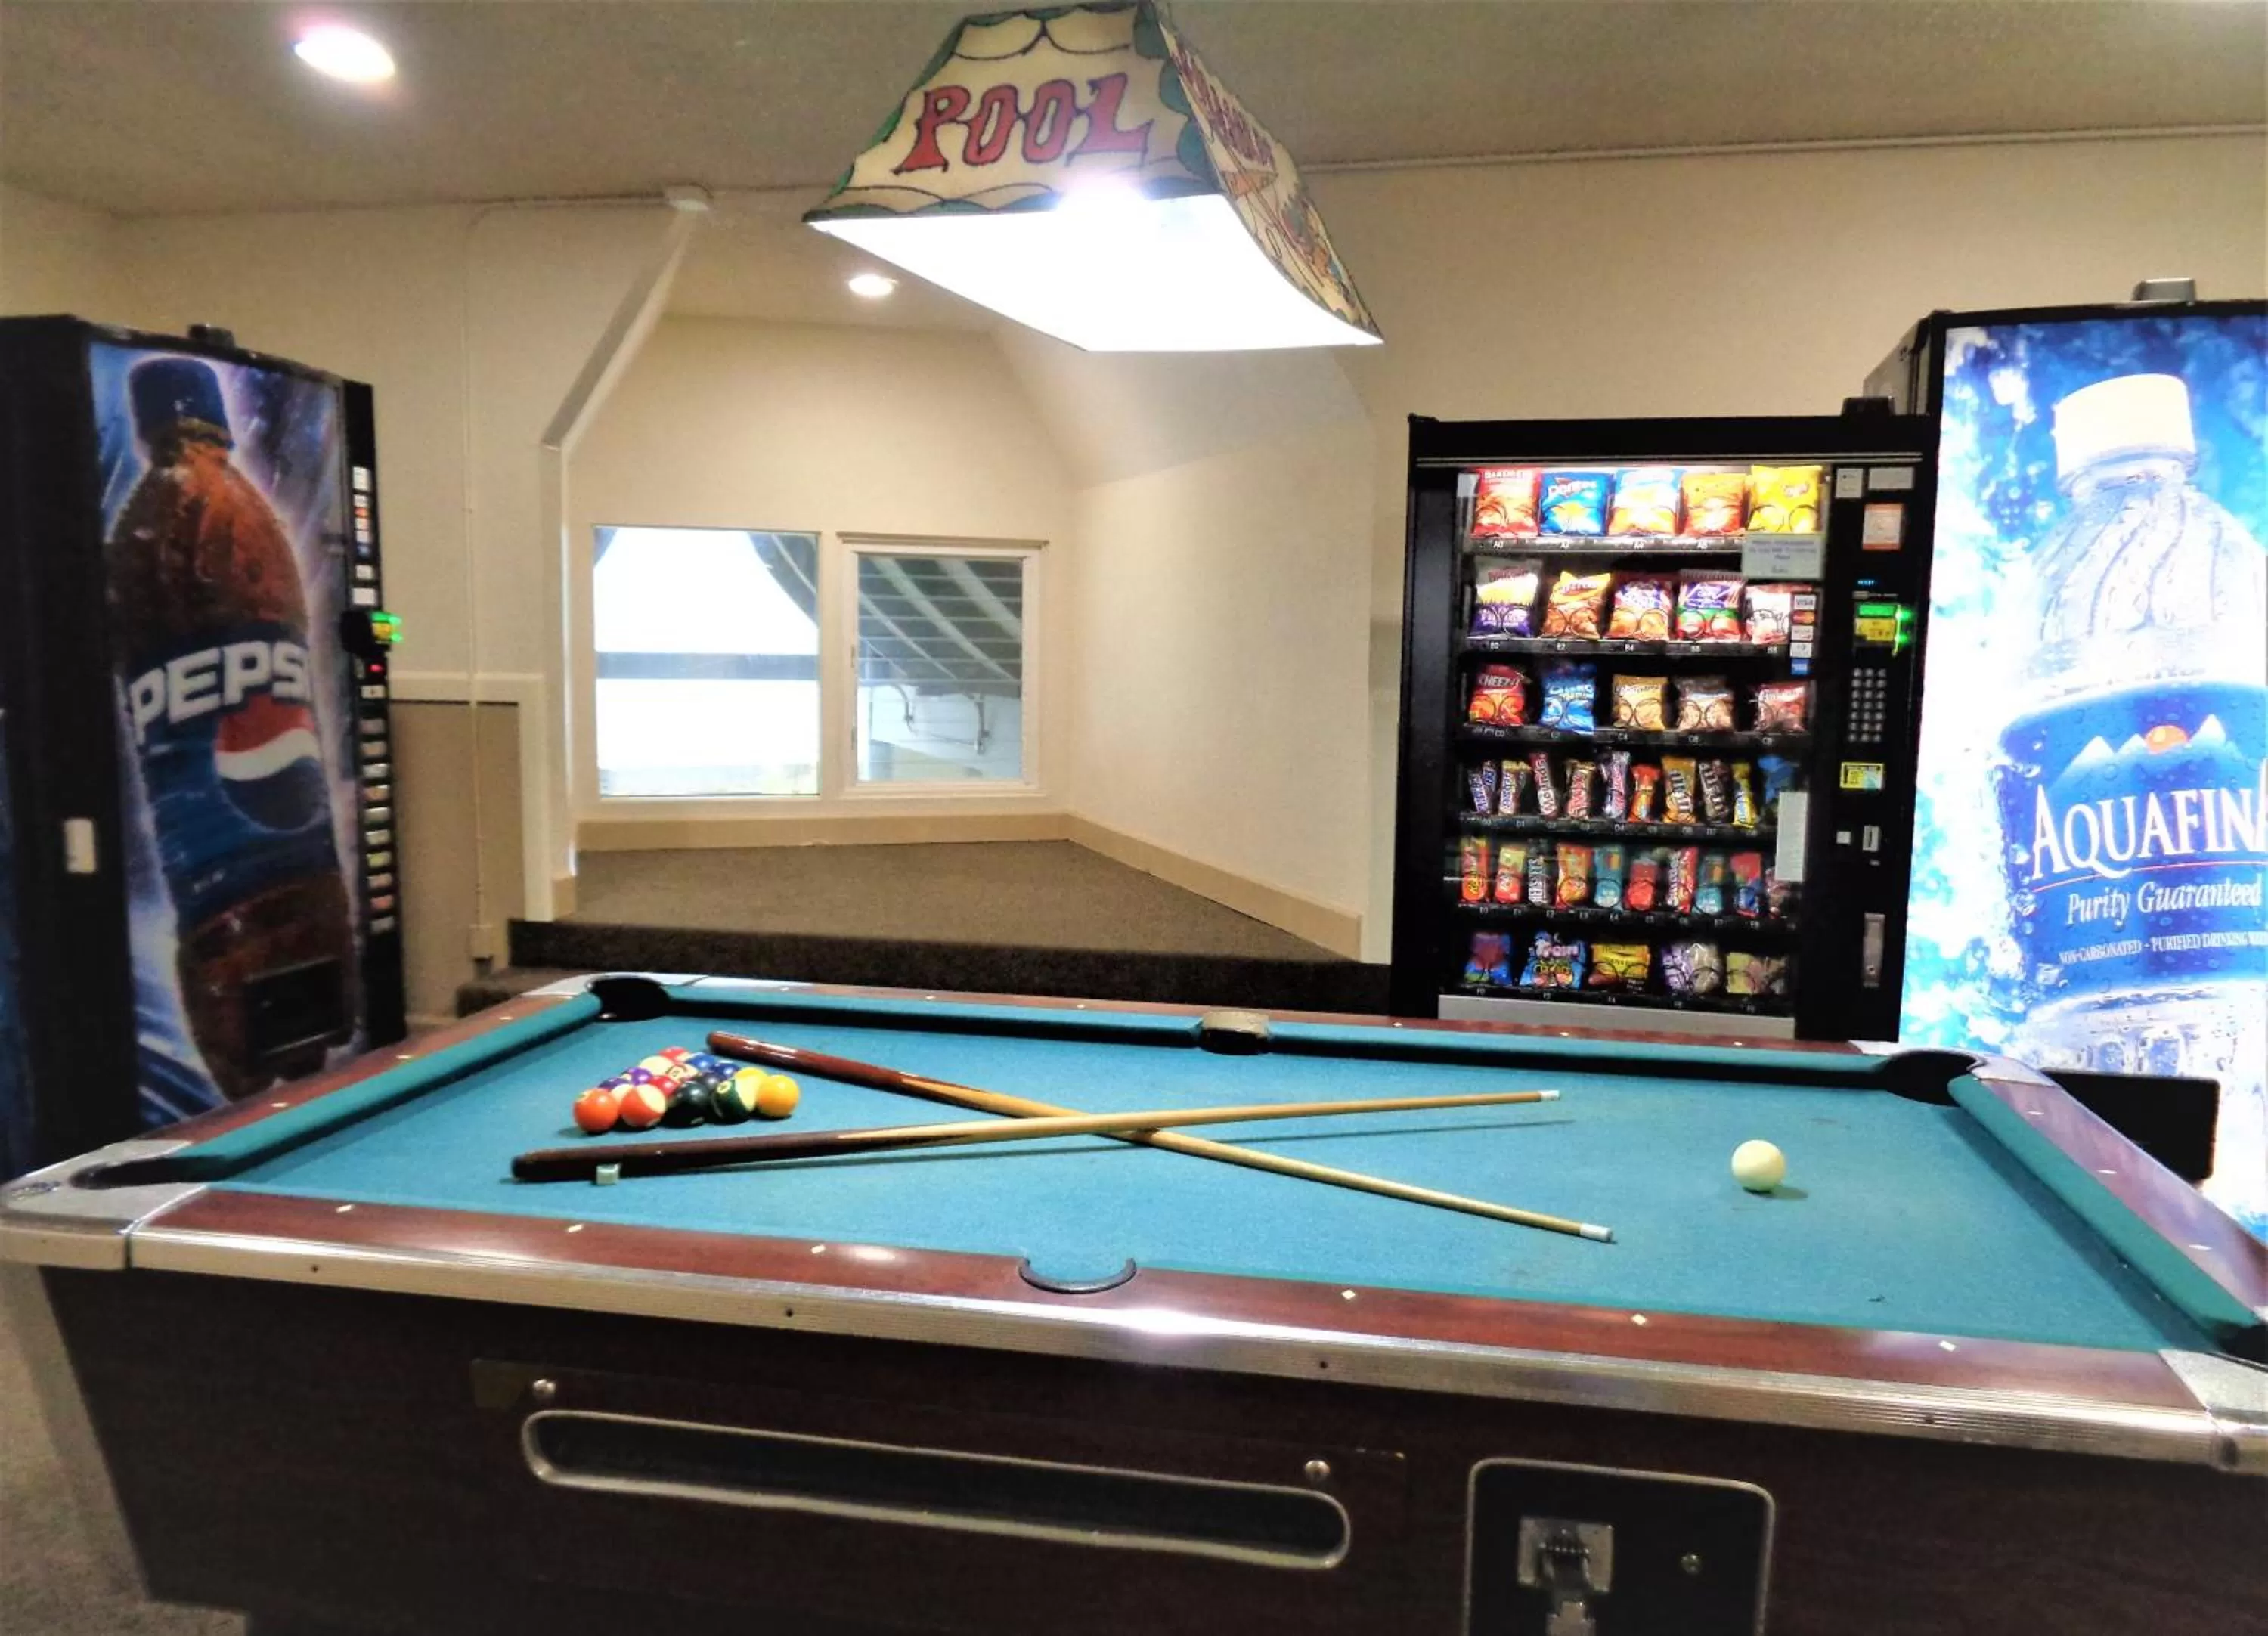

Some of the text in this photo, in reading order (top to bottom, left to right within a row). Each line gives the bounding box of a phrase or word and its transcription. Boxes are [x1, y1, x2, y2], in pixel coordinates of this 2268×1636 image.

[892, 72, 1154, 175] POOL
[130, 640, 311, 745] PEPS
[2067, 872, 2262, 925] Purity Guaranteed
